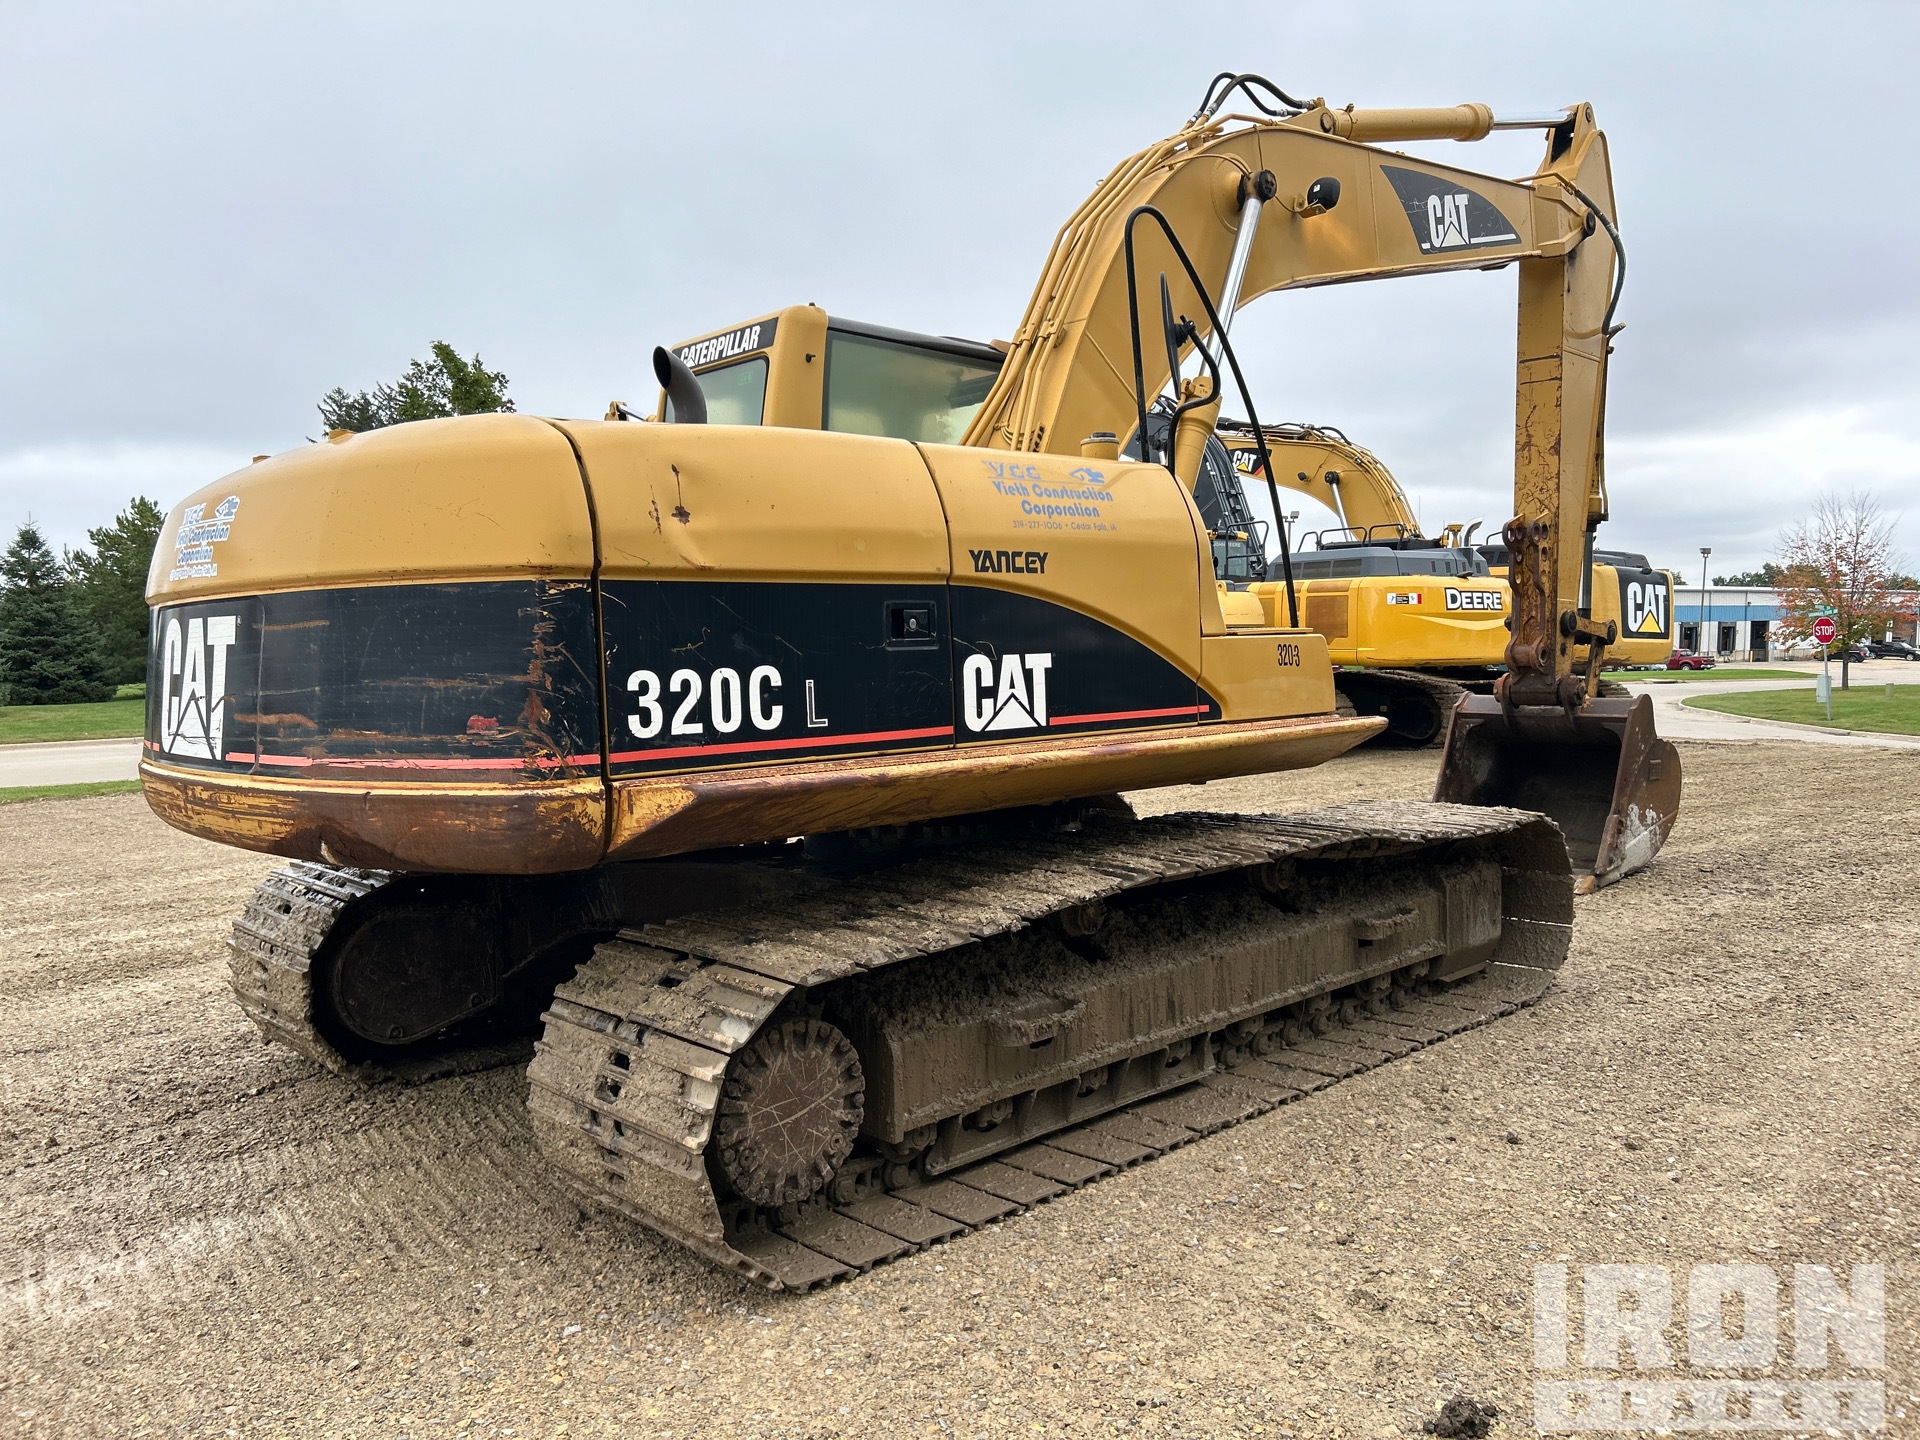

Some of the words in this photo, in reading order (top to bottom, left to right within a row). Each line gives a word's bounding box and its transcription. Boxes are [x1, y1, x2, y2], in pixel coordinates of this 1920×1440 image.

[1427, 194, 1469, 248] CAT
[680, 325, 761, 367] CATERPILLAR
[982, 461, 1041, 480] VCC
[1232, 450, 1257, 472] CAT
[992, 481, 1030, 497] Vieth
[1031, 483, 1114, 502] Construction
[1021, 499, 1100, 519] Corporation
[968, 550, 1049, 574] YANCEY
[1445, 588, 1503, 610] DEERE
[1627, 582, 1667, 633] CAT
[1815, 625, 1834, 636] STOP
[161, 615, 237, 761] CAT
[962, 652, 1053, 732] CAT
[626, 664, 784, 739] 320C
[805, 679, 829, 728] L
